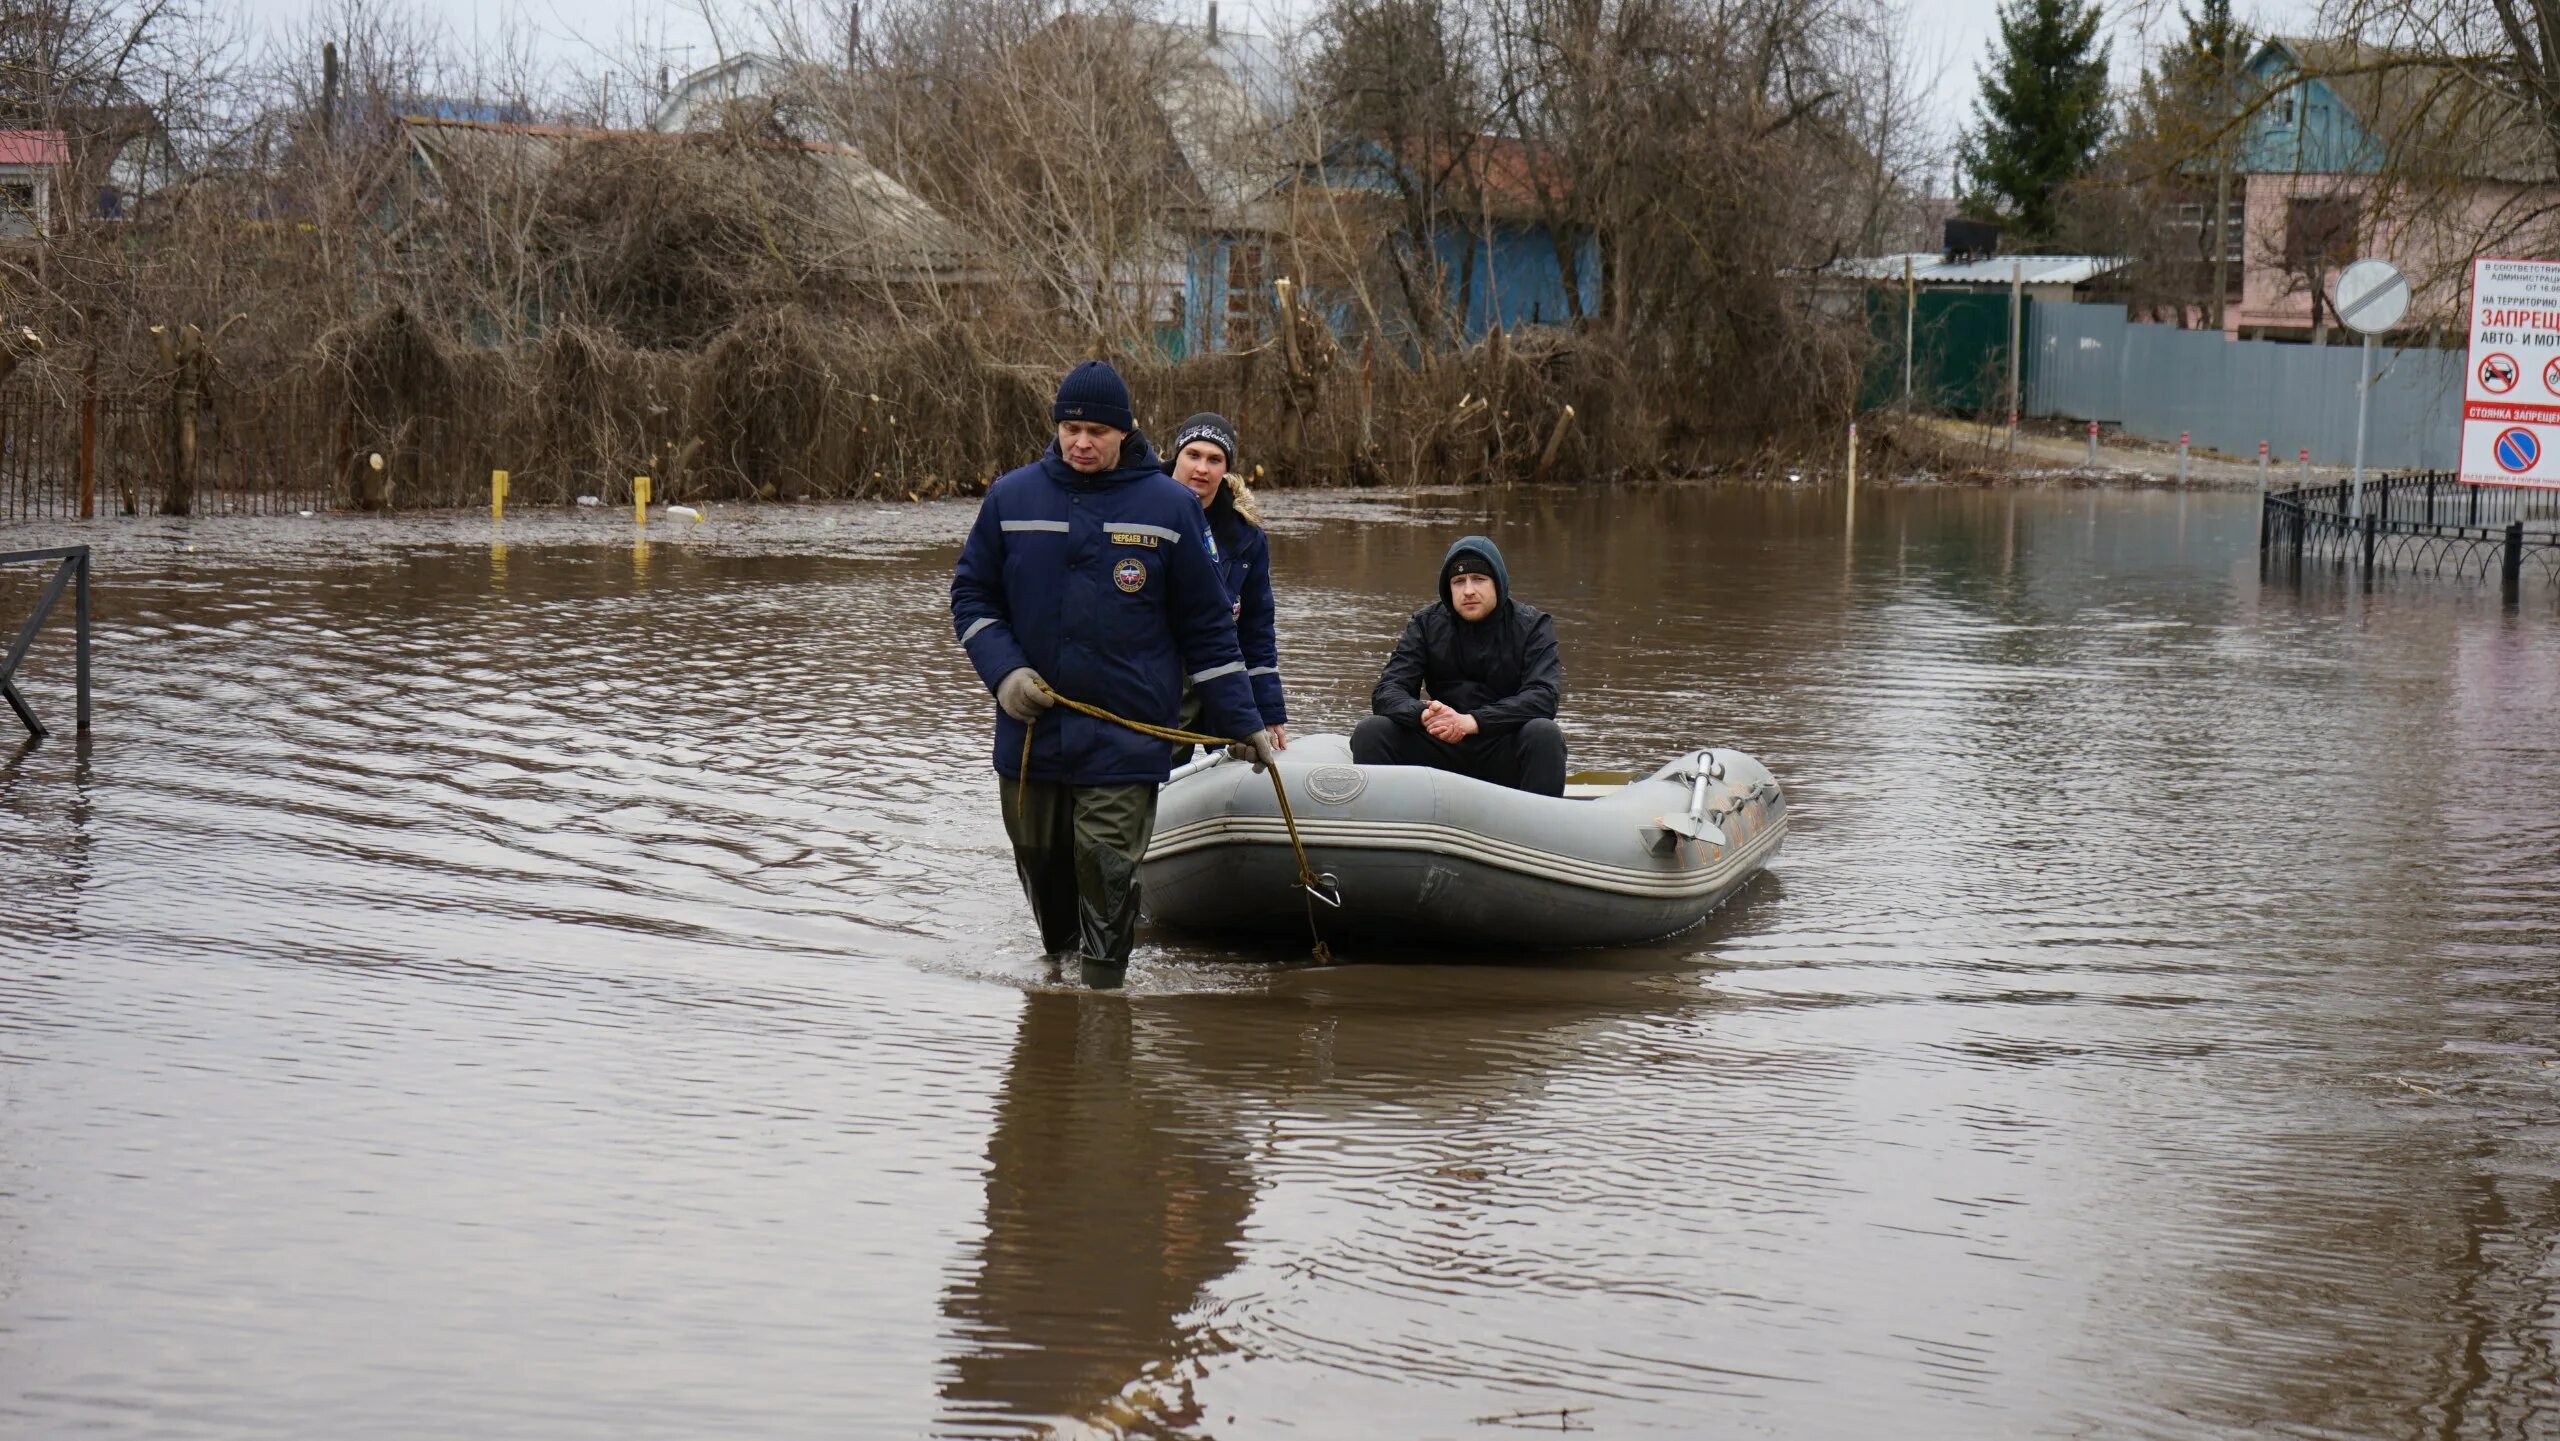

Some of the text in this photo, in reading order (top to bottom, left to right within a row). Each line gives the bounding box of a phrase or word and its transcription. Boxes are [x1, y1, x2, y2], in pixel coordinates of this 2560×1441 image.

[2485, 263, 2491, 271] В
[2525, 284, 2536, 292] ОТ
[2482, 295, 2557, 308] НА ТЕРРИТОРИЮ
[2482, 309, 2560, 332] ЗАПРЕЩ
[2522, 333, 2531, 346] И
[2470, 407, 2511, 420] СТОЯНКА
[1113, 534, 1141, 543] ЧЕРБАЕВ
